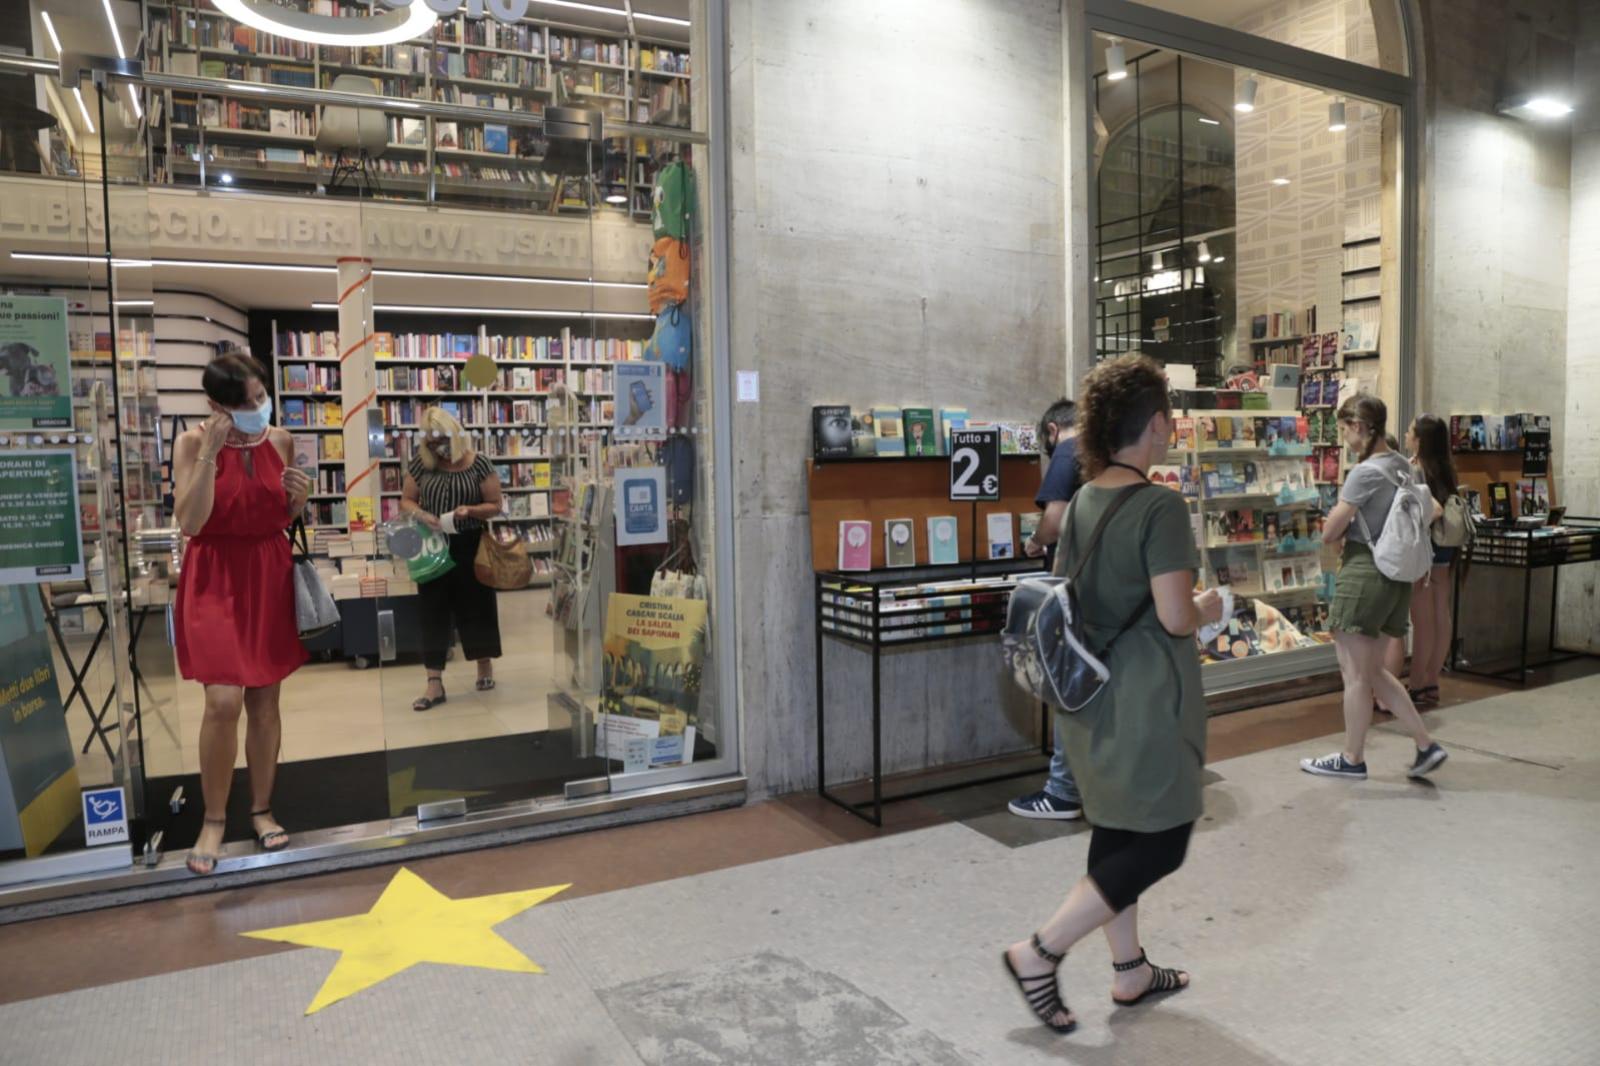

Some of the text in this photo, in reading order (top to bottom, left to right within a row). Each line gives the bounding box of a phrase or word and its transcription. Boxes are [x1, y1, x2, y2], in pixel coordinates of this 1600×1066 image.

[256, 209, 353, 246] LIBRI
[14, 311, 60, 322] passioni!
[953, 434, 982, 444] Tutto
[35, 459, 46, 468] DI
[639, 601, 673, 611] CRISTINA
[627, 627, 640, 635] DEI
[88, 826, 125, 839] RAMPA
